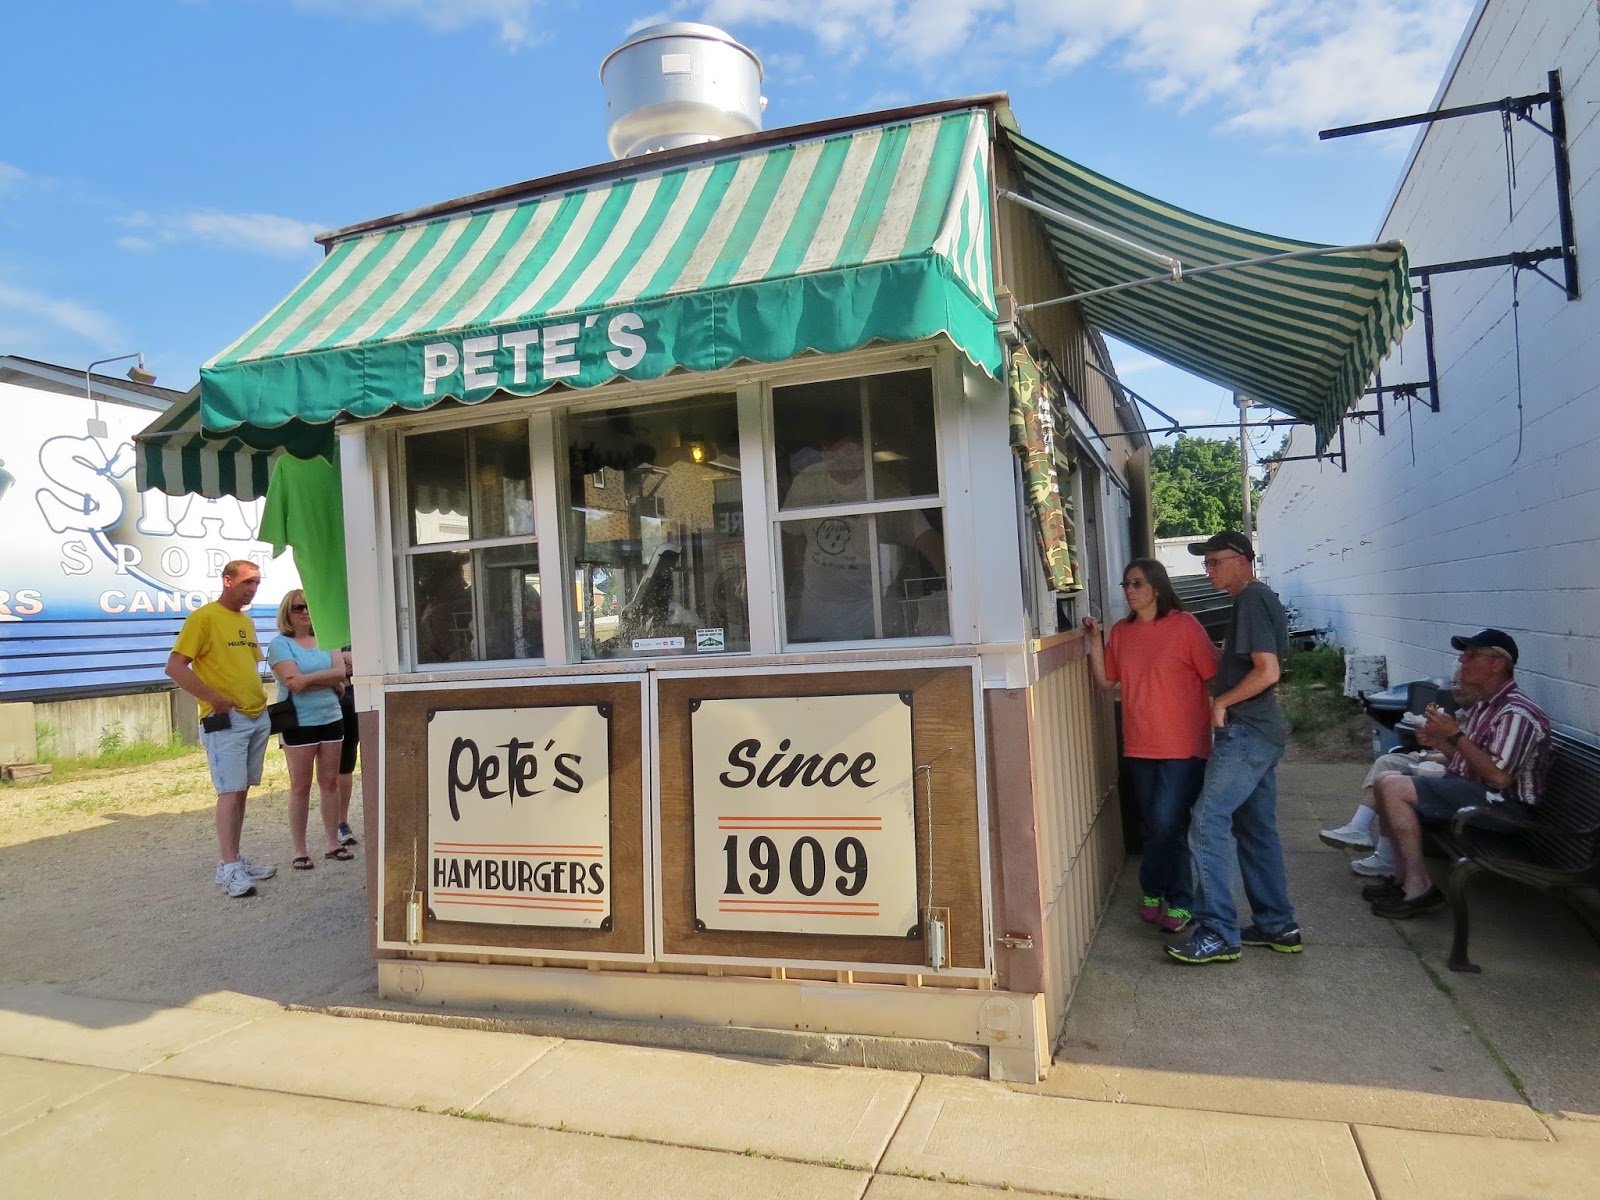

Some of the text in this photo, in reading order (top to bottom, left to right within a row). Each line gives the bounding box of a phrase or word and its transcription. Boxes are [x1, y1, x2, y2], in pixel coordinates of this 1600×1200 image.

[423, 312, 648, 396] PETE'S
[99, 588, 253, 615] CANO
[447, 736, 584, 822] Pete's
[719, 738, 881, 788] Since
[433, 857, 605, 895] HAMBURGERS
[722, 834, 869, 897] 1909
